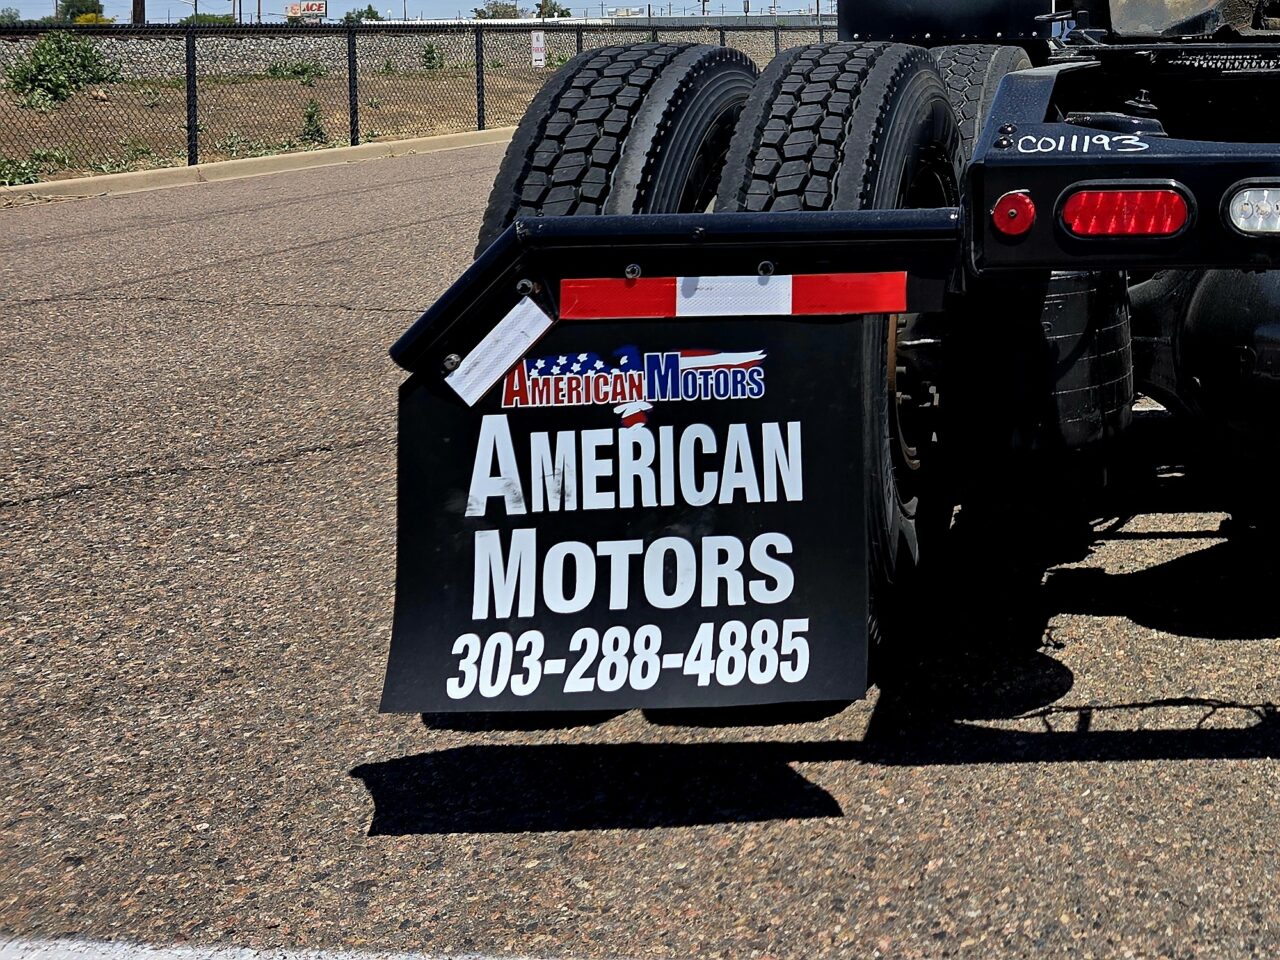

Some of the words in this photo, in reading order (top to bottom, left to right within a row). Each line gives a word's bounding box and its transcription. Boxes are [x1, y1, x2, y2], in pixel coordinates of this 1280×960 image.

[302, 2, 325, 12] ACE
[502, 359, 645, 408] AMERICAN
[644, 352, 766, 402] MOTORS
[465, 414, 803, 517] AMERICAN
[472, 528, 794, 620] MOTORS
[446, 618, 810, 700] 303-288-4885
